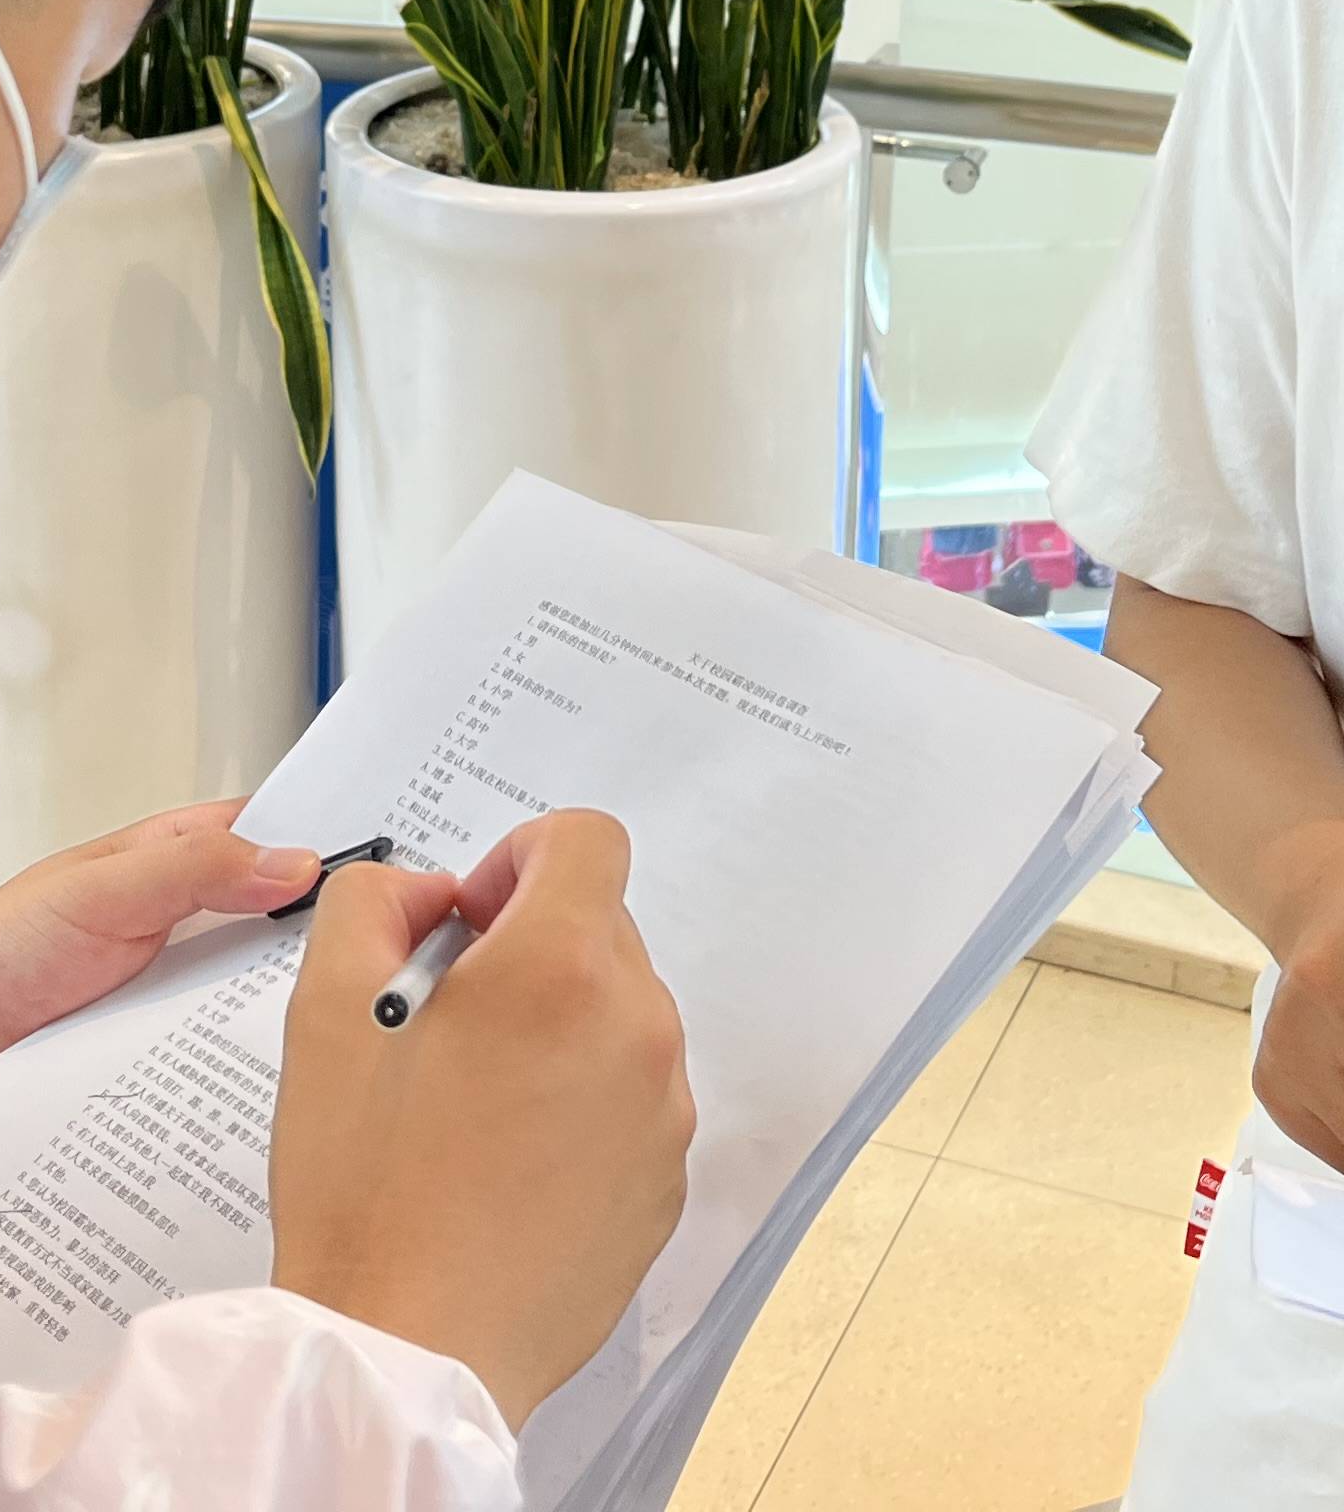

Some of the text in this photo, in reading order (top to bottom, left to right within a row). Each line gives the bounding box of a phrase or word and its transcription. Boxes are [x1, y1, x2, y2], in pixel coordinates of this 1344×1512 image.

[432, 745, 553, 812] 3.您认为现在校园暴力事
